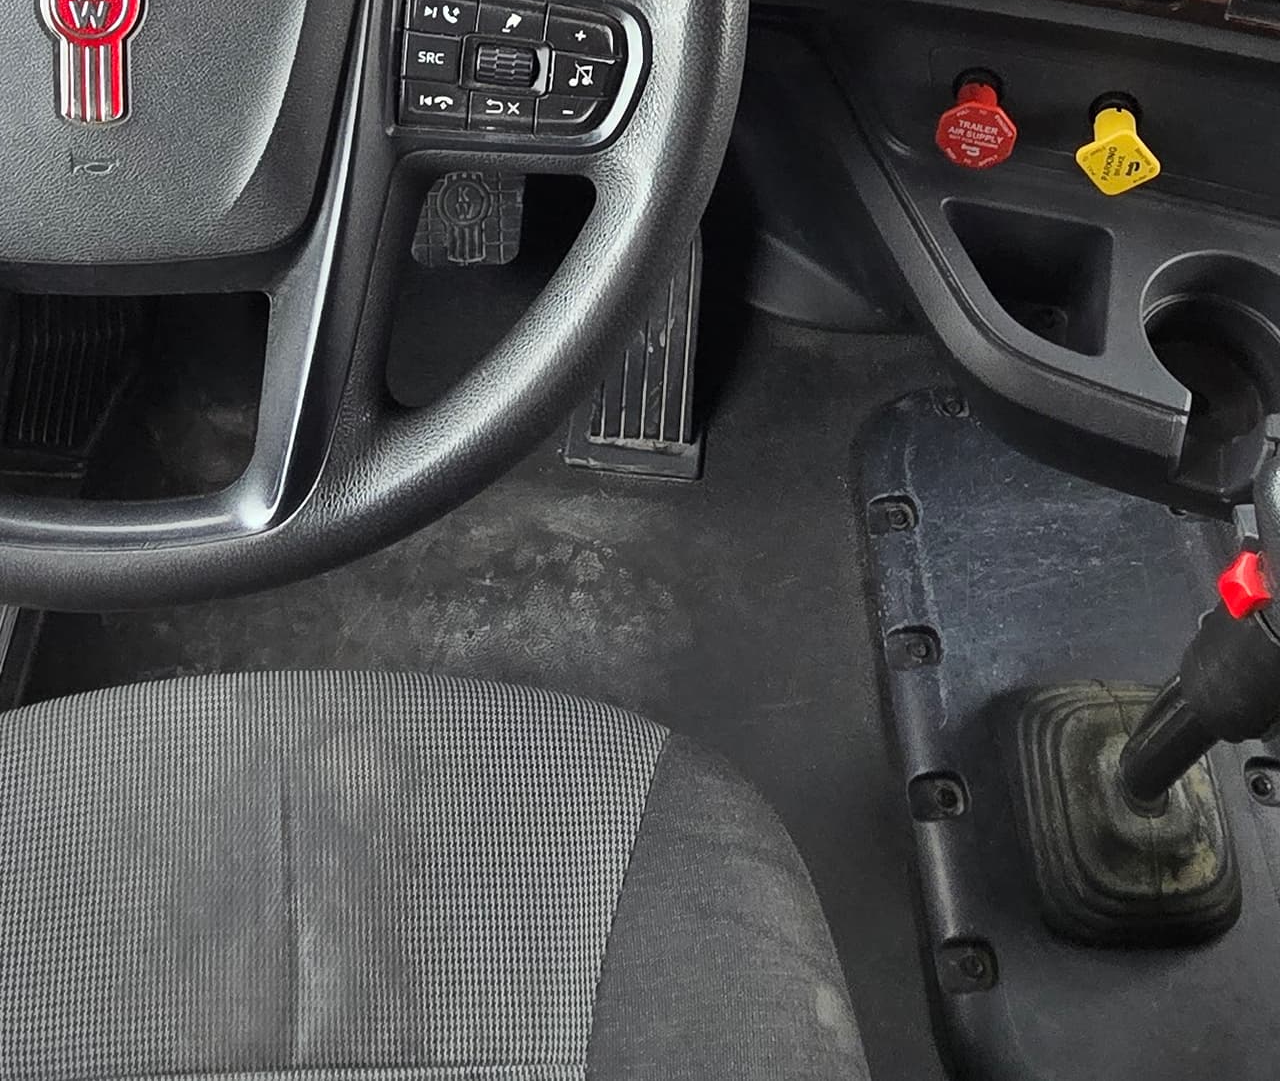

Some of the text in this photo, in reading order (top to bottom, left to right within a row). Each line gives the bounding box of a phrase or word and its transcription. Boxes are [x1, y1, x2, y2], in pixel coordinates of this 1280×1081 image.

[69, 0, 111, 29] W
[417, 51, 445, 65] SRC
[948, 127, 1004, 144] AIR SUPPLY
[959, 119, 999, 136] TRAILER
[1101, 146, 1118, 182] PARKING
